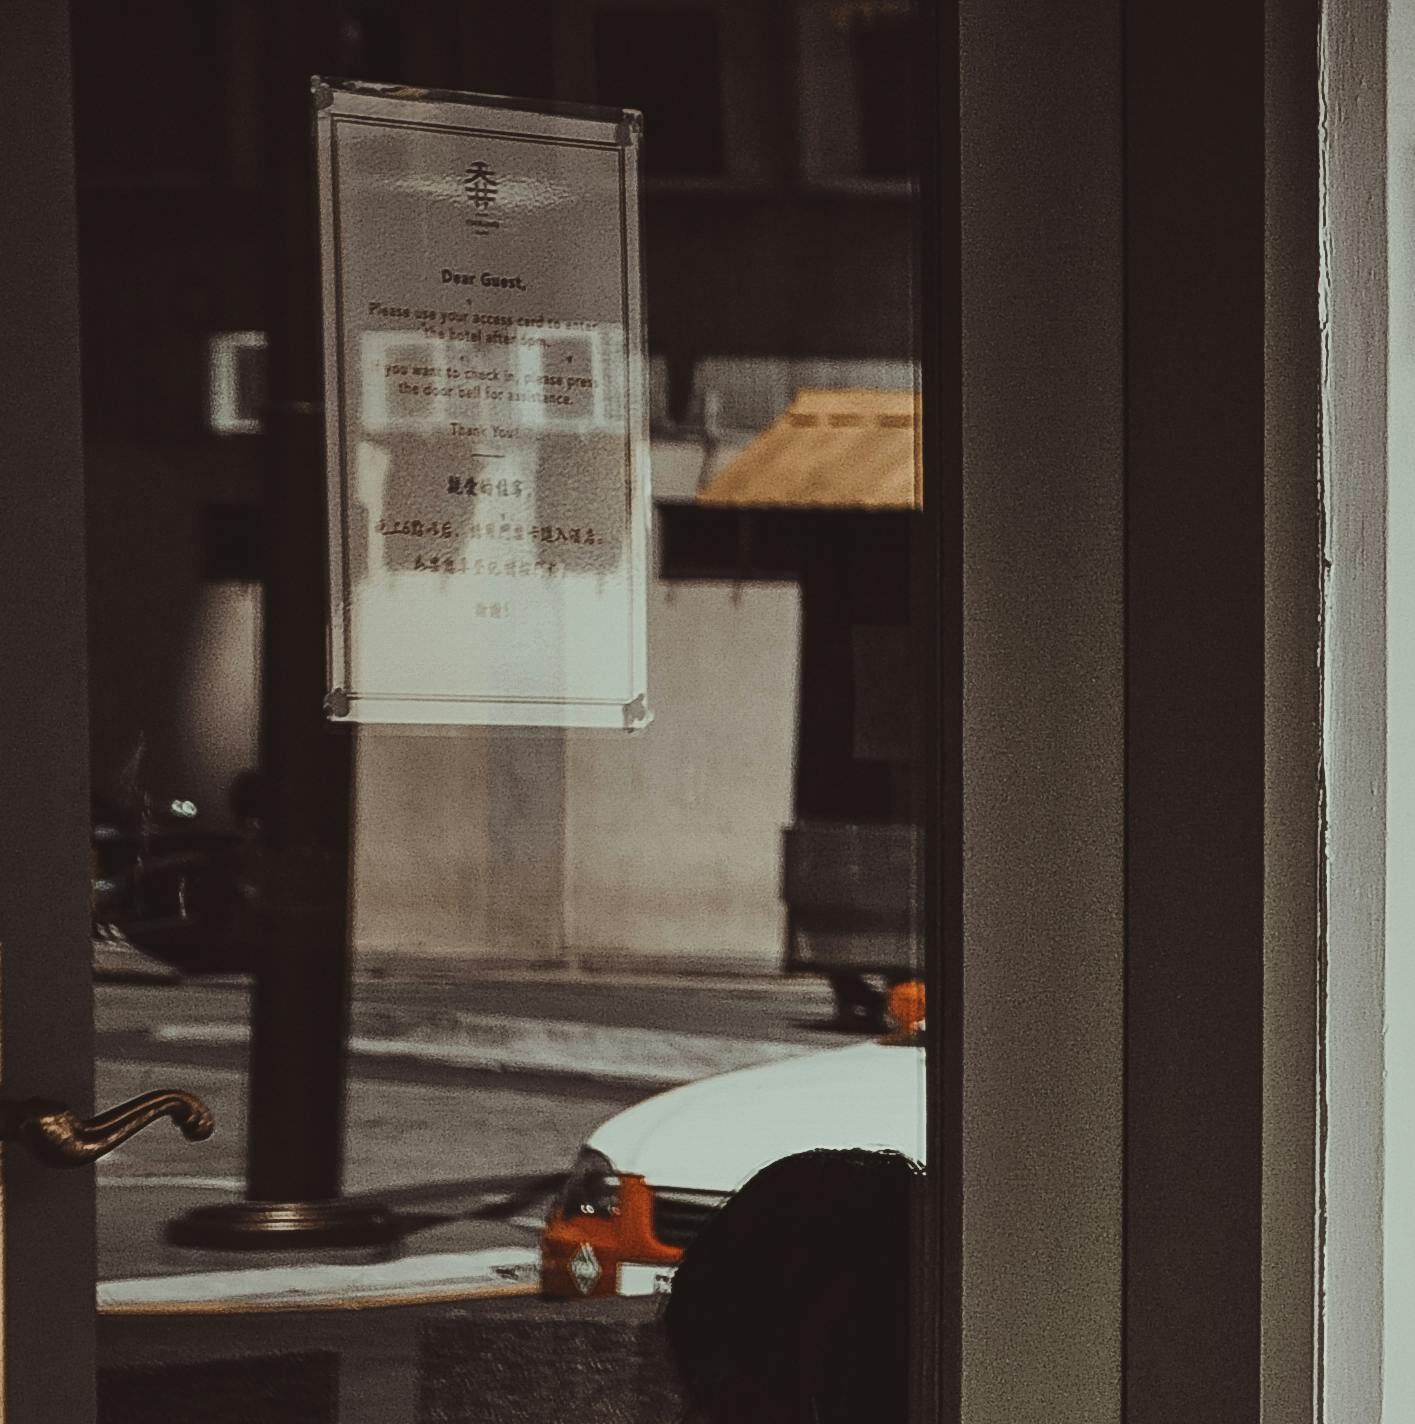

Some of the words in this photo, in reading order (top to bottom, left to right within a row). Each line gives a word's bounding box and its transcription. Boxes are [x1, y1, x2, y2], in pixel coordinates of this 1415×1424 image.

[441, 268, 476, 286] Dear
[480, 271, 527, 292] Guest,
[369, 303, 410, 318] Please
[413, 309, 437, 321] use
[440, 312, 469, 325] your
[472, 314, 512, 326] access
[516, 315, 545, 328] card
[449, 328, 481, 343] hotel
[485, 331, 517, 345] after
[385, 364, 409, 379] you
[446, 367, 460, 379] to
[398, 382, 420, 396] the
[423, 384, 453, 398] door
[450, 422, 487, 438] Thank
